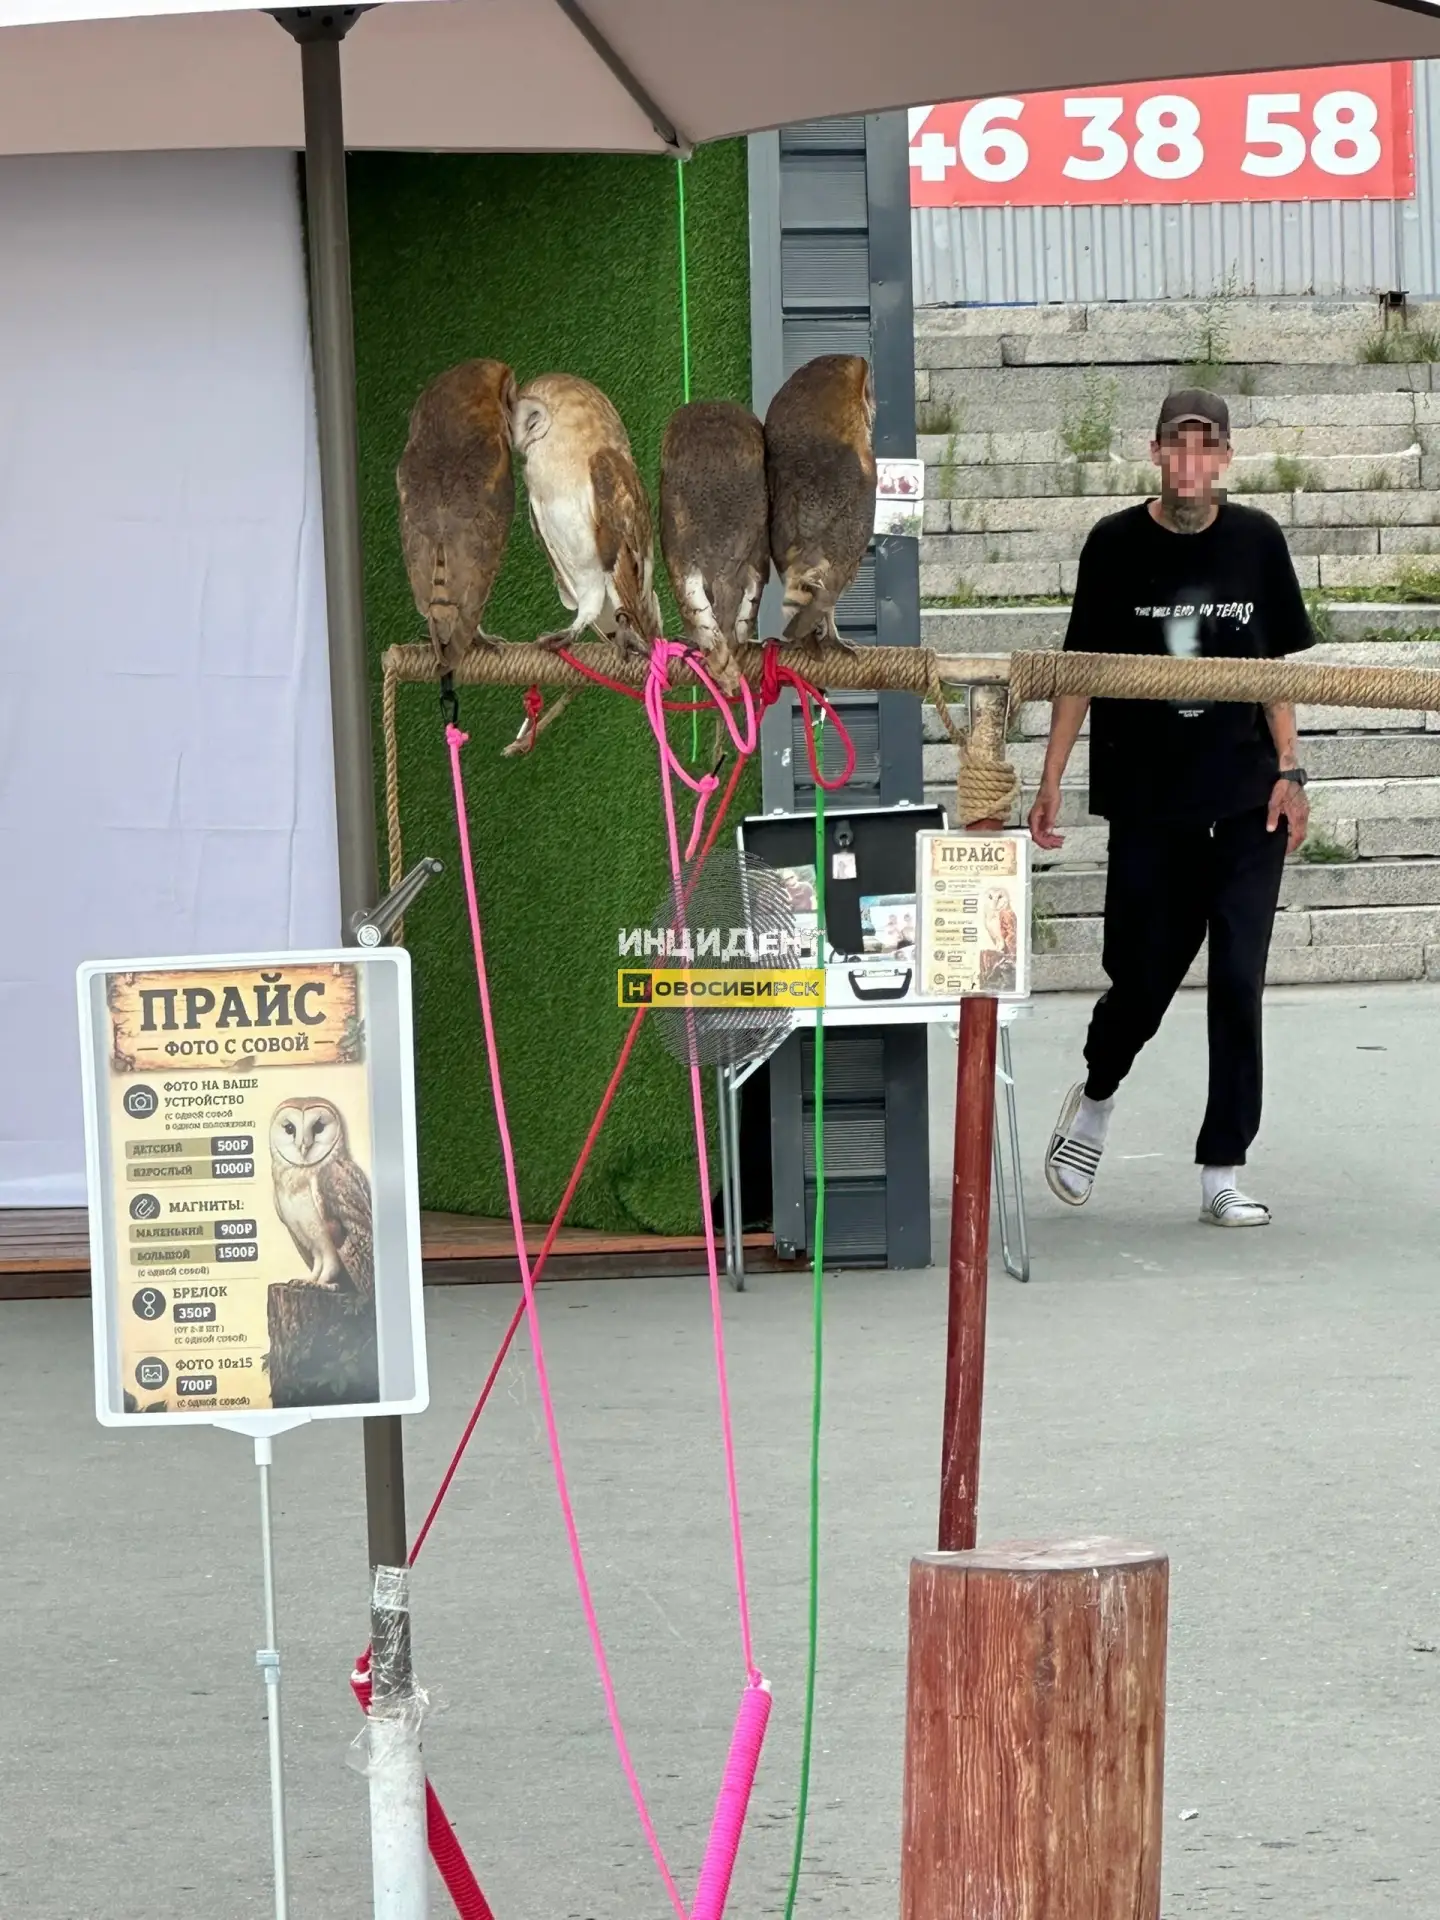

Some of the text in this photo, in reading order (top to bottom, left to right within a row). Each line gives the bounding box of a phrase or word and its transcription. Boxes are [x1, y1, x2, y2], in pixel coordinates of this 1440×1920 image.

[909, 90, 1381, 183] 46 38 58
[1174, 605, 1195, 617] END
[1200, 603, 1213, 617] IN
[941, 843, 1005, 862] ПРАЙС
[139, 972, 326, 1031] ПРАЙС
[165, 1032, 309, 1057] ФОТО С СОВОЙ
[164, 1078, 259, 1092] ФОТО НА ВАШЕ
[164, 1094, 244, 1108] УСТРОЙСТВО
[133, 1142, 183, 1155] ДЕТСКИЙ
[169, 1199, 244, 1213] МАГНИТЫ:
[136, 1225, 204, 1238] МАЛЕНЬКИЙ
[137, 1249, 191, 1262] БОЛЬШОЙ
[172, 1286, 228, 1299] БРЕЛОК
[175, 1359, 214, 1370] ФОТО
